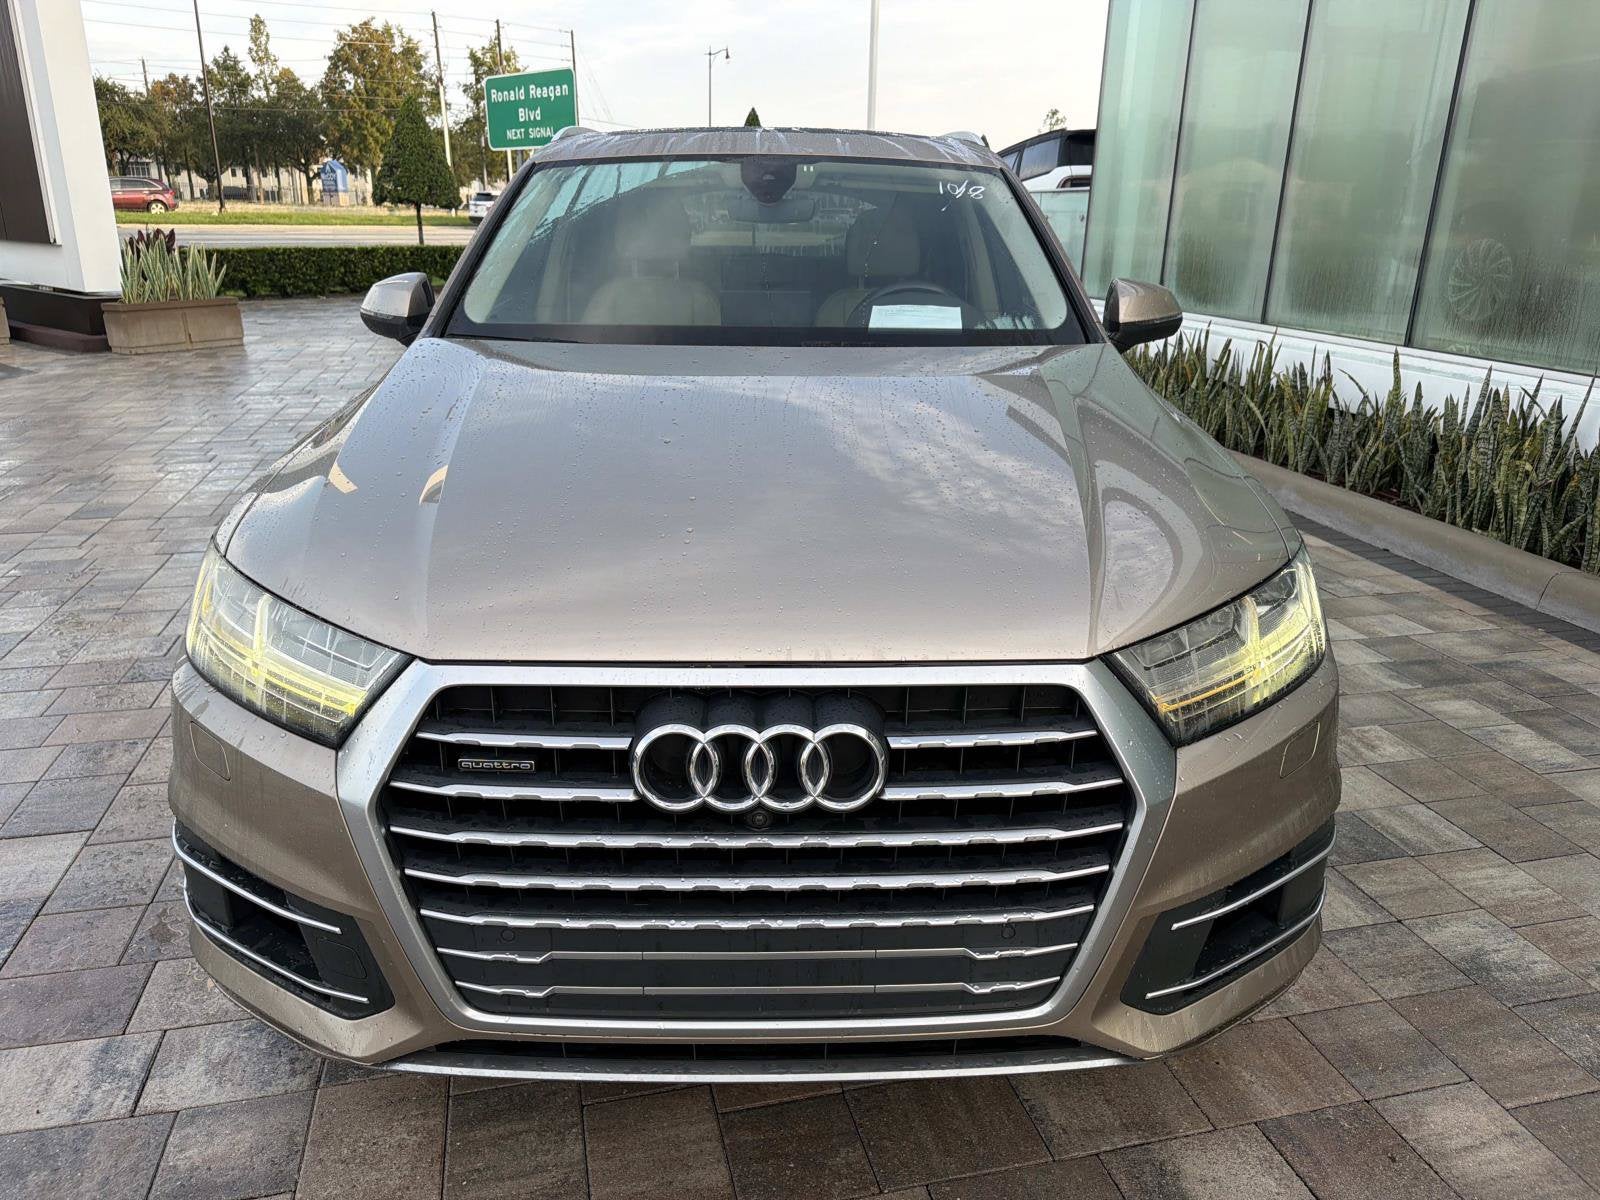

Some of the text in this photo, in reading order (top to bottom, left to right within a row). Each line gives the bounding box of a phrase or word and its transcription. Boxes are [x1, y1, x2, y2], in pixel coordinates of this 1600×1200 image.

[490, 83, 569, 103] Ronald Reagan
[518, 106, 542, 122] Blvd
[506, 126, 555, 140] NEXT SIGNAL
[461, 761, 531, 769] quattro
